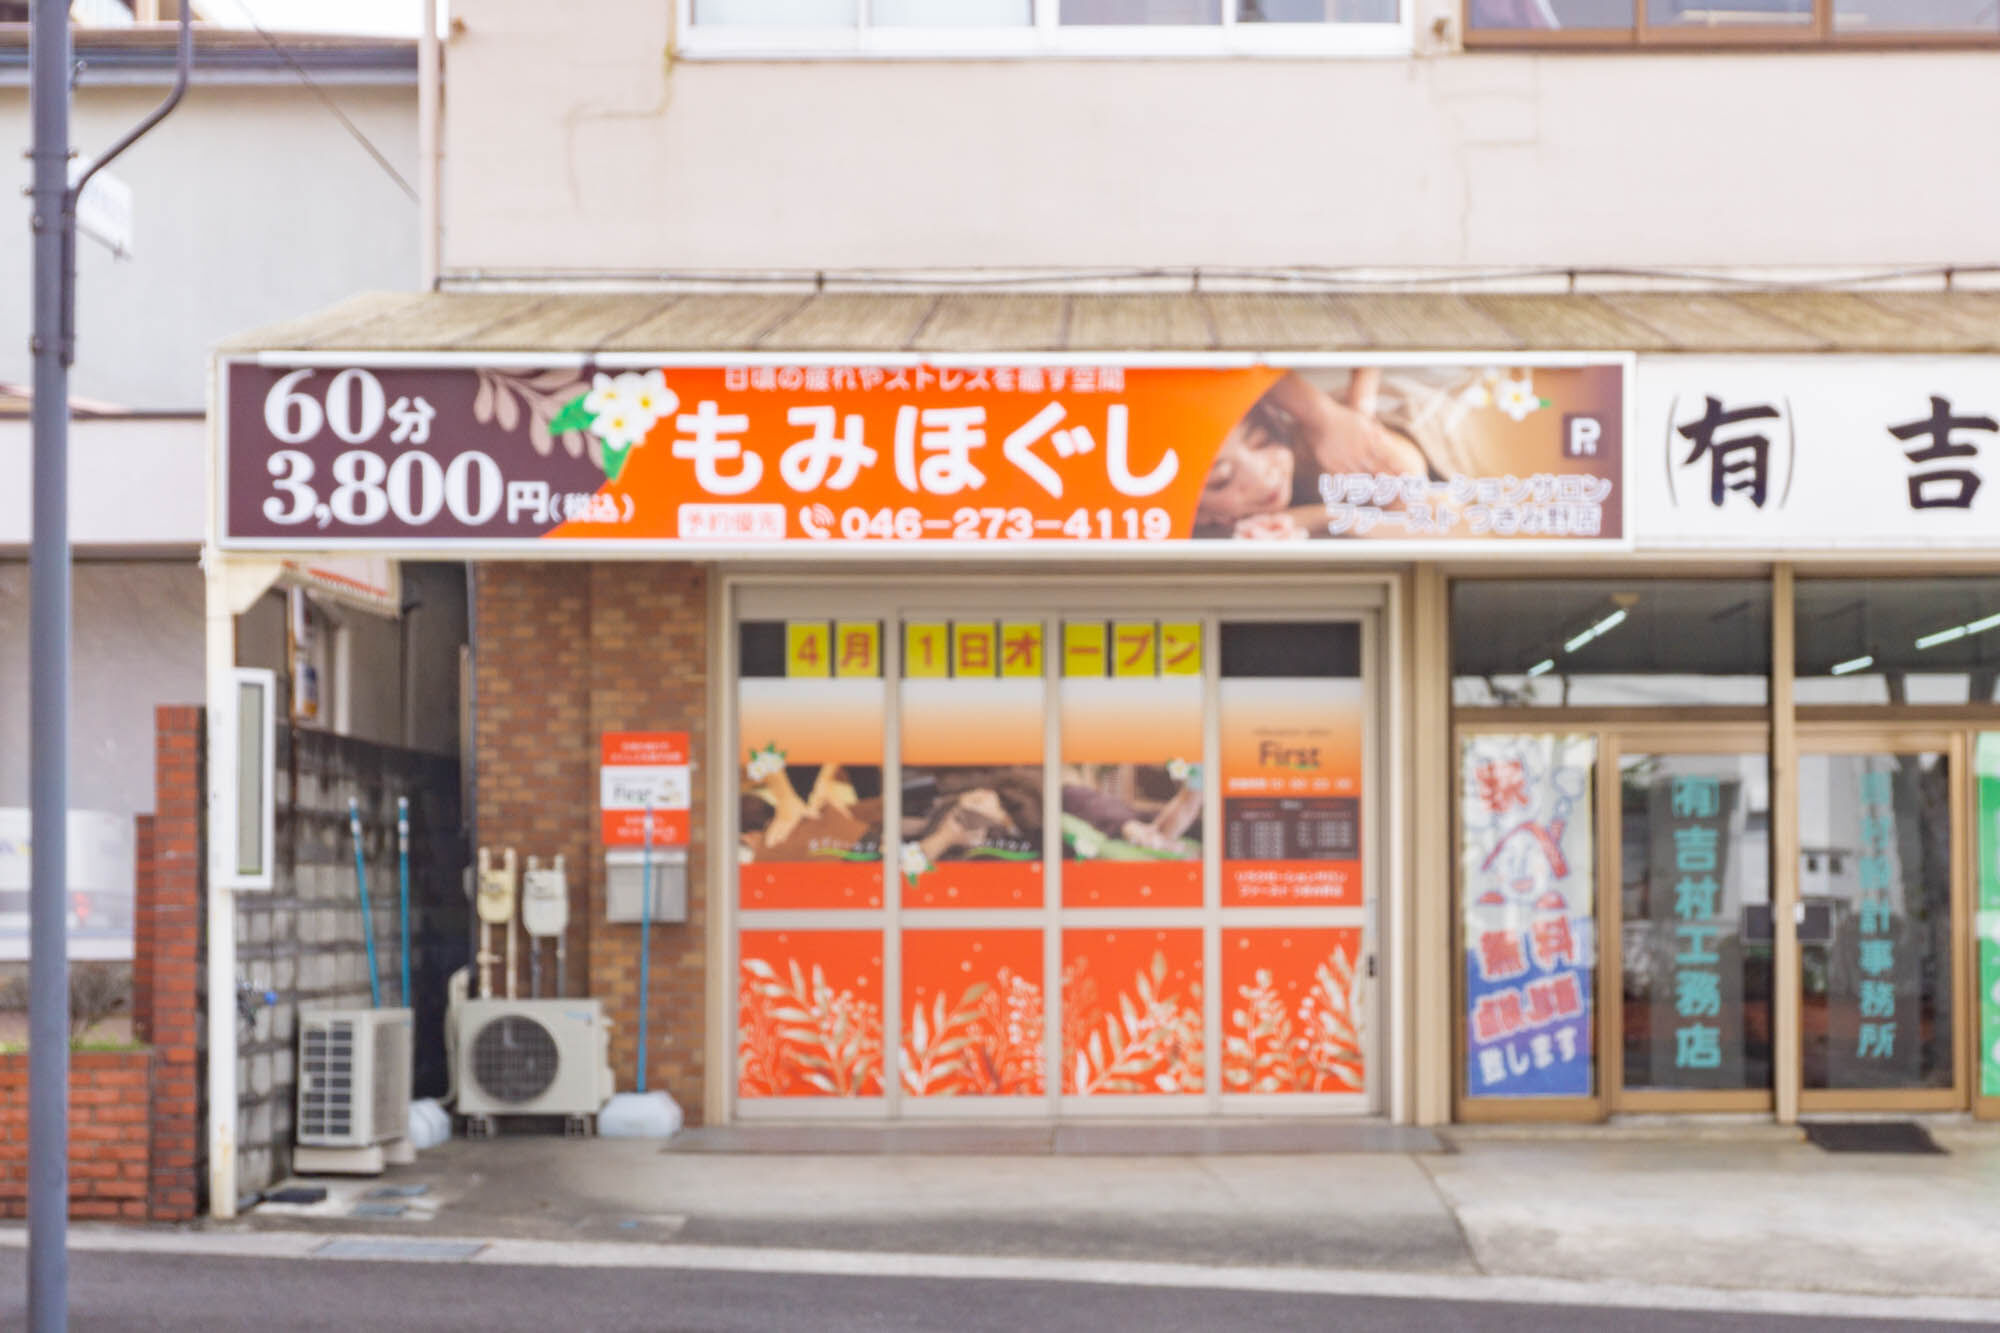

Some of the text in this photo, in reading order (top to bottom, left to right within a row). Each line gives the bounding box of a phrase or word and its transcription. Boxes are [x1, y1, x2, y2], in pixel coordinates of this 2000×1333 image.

[263, 368, 436, 444] 60分
[671, 400, 1180, 500] もみほぐし
[841, 507, 1172, 539] 046-273-4119
